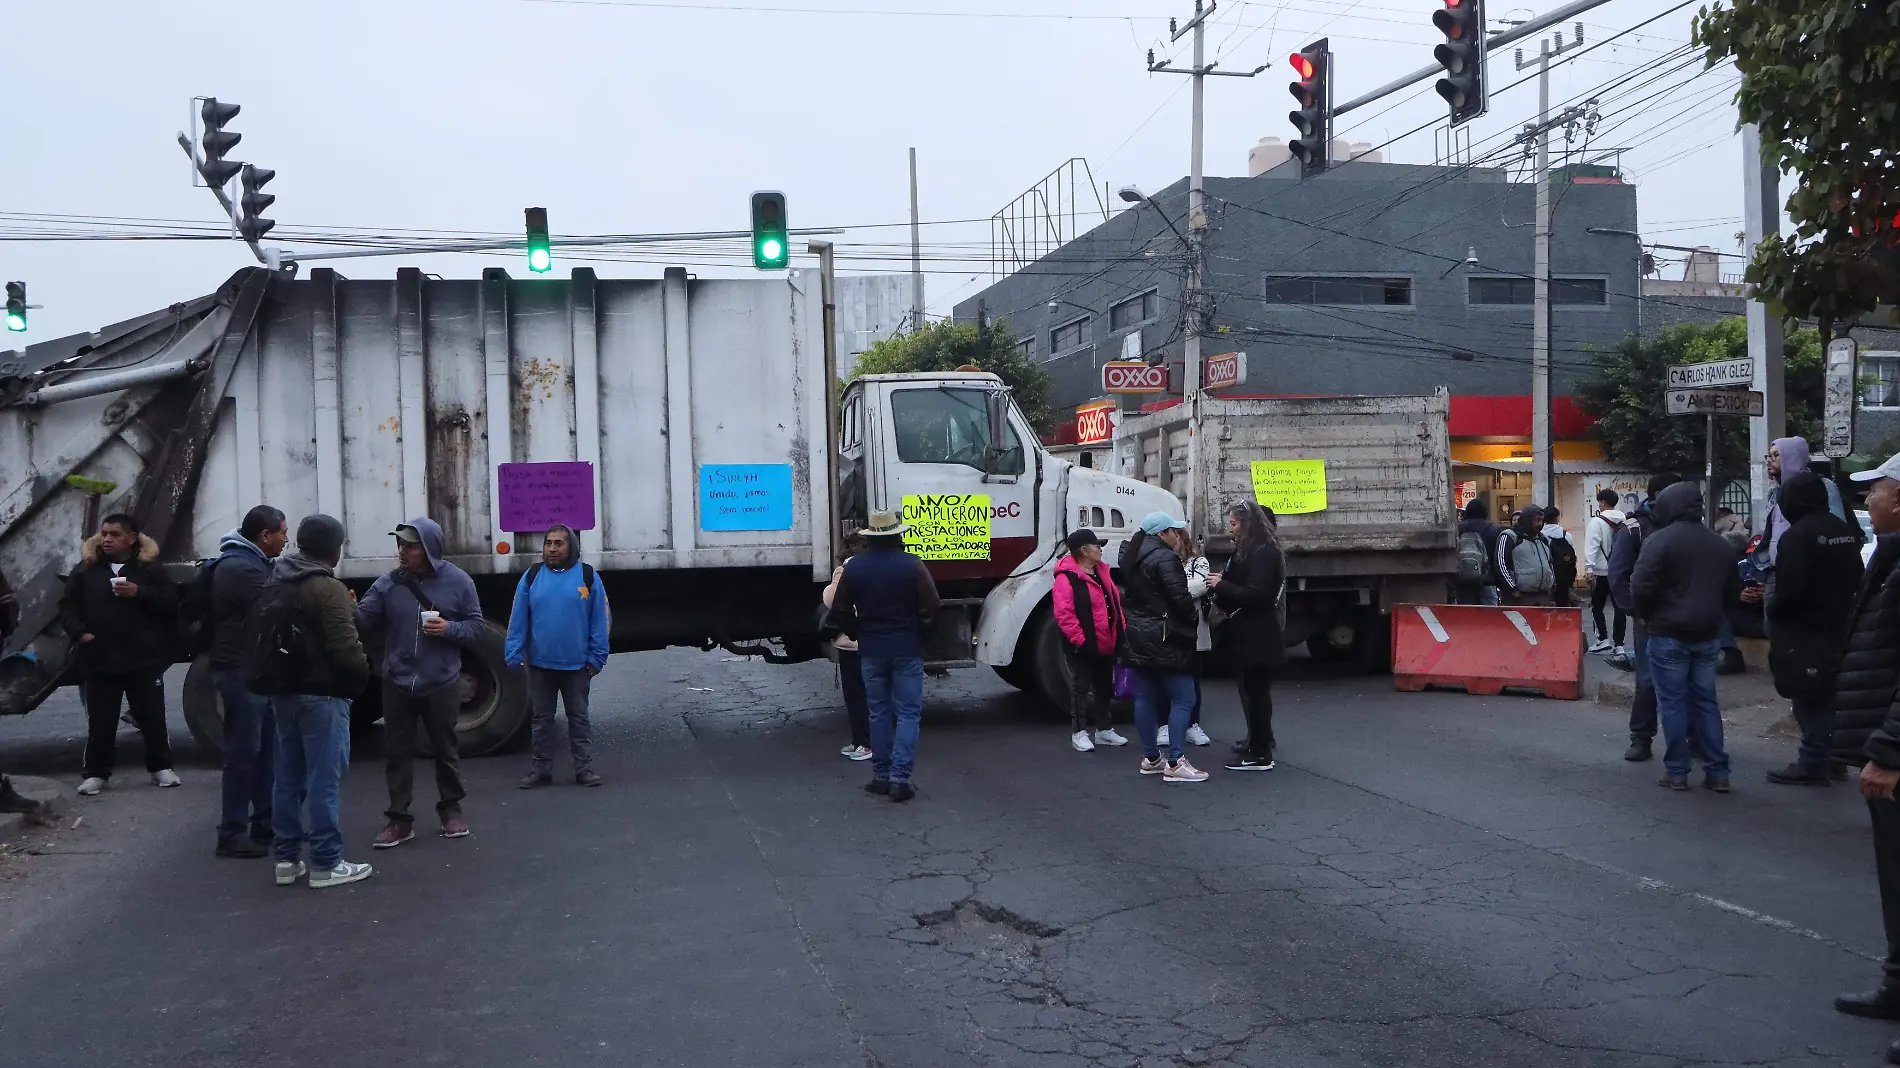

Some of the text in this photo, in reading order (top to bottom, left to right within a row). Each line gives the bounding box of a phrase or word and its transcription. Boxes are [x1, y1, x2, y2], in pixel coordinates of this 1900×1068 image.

[1108, 366, 1163, 389] OXXO
[1209, 360, 1236, 384] OXXO
[1670, 367, 1704, 384] CARLOS
[1705, 365, 1728, 381] HANK
[1078, 409, 1107, 443] OXXO
[1116, 486, 1135, 497] 0144
[902, 505, 988, 522] CUMPLIERON
